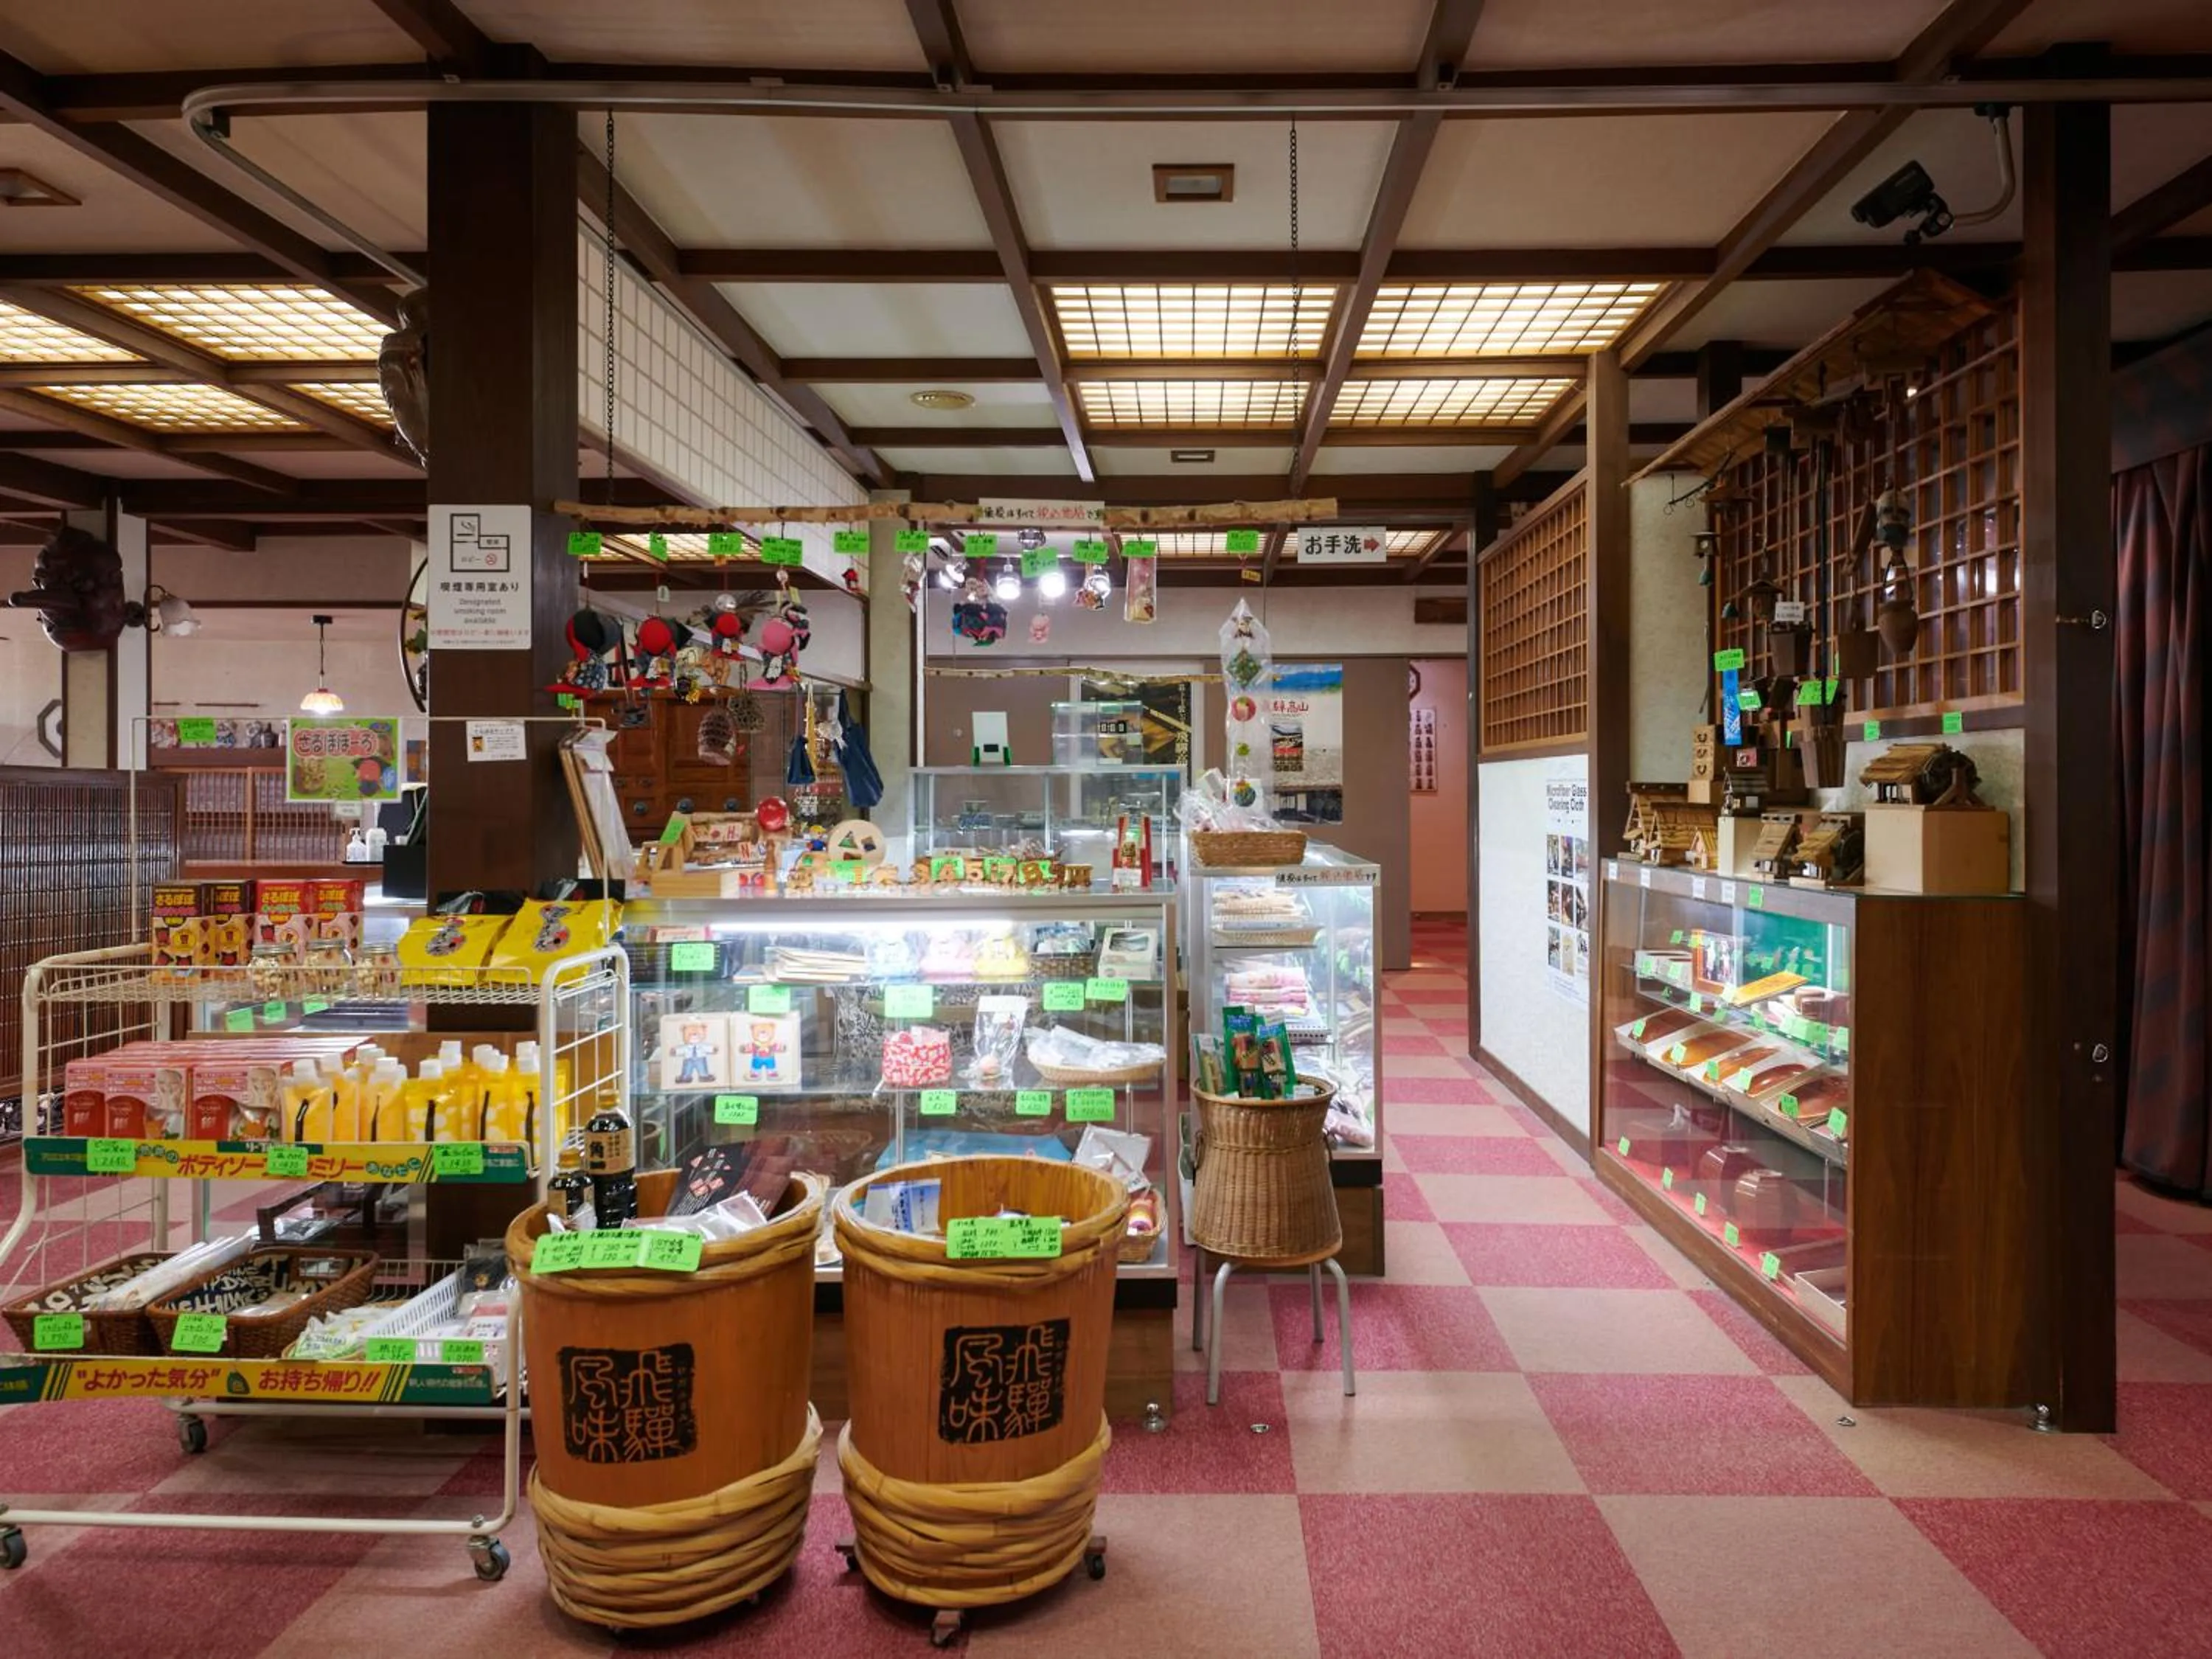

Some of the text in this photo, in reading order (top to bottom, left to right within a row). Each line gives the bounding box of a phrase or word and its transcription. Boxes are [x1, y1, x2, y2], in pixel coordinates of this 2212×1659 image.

[440, 582, 519, 592] 喫煙専用室あり
[1571, 784, 1587, 797] Glass
[177, 1154, 364, 1178] ボディソーミリー
[1304, 1272, 1362, 1292] お手洗
